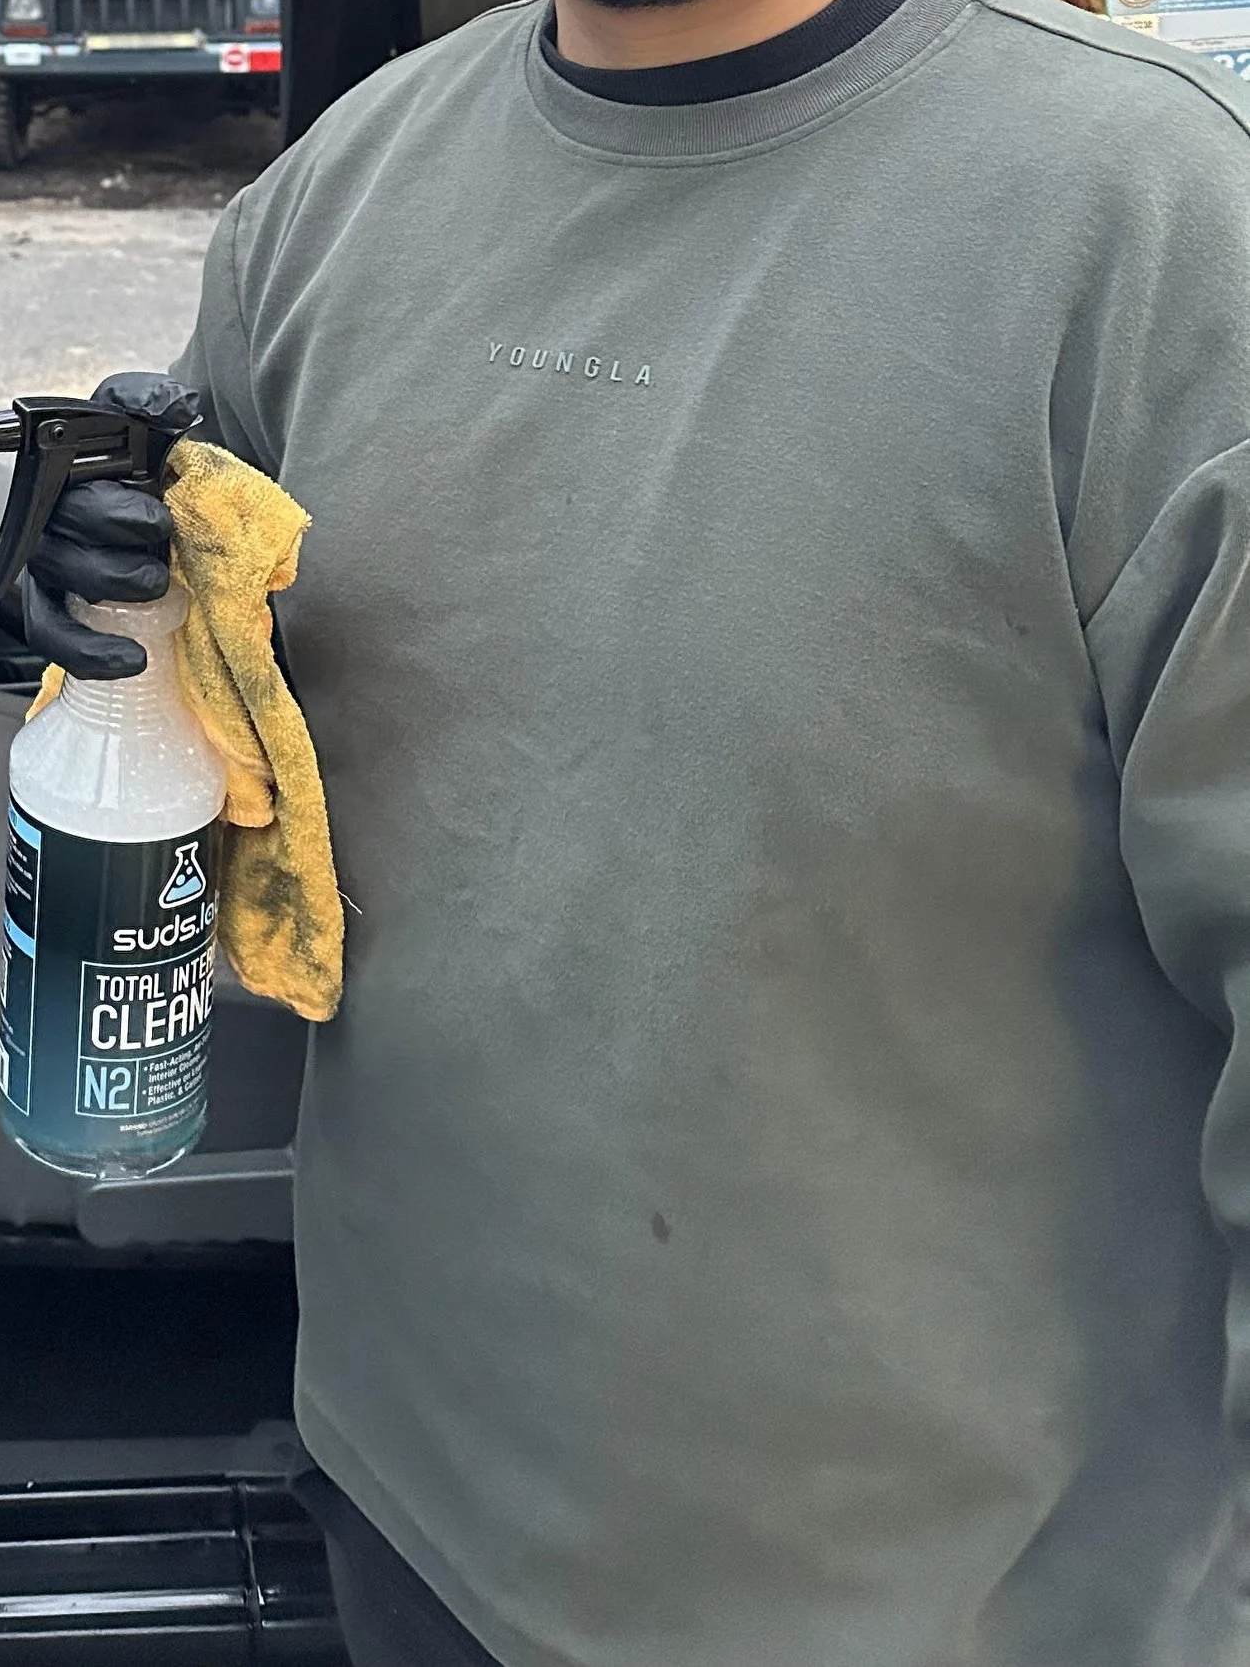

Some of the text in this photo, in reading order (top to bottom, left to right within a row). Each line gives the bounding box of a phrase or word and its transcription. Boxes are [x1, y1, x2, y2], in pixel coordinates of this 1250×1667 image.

[488, 341, 652, 386] YOUNGLA
[95, 941, 216, 1002] TOTAL INTER
[90, 968, 214, 1050] CLEANE
[84, 1064, 130, 1110] N2
[148, 1078, 182, 1096] Effective
